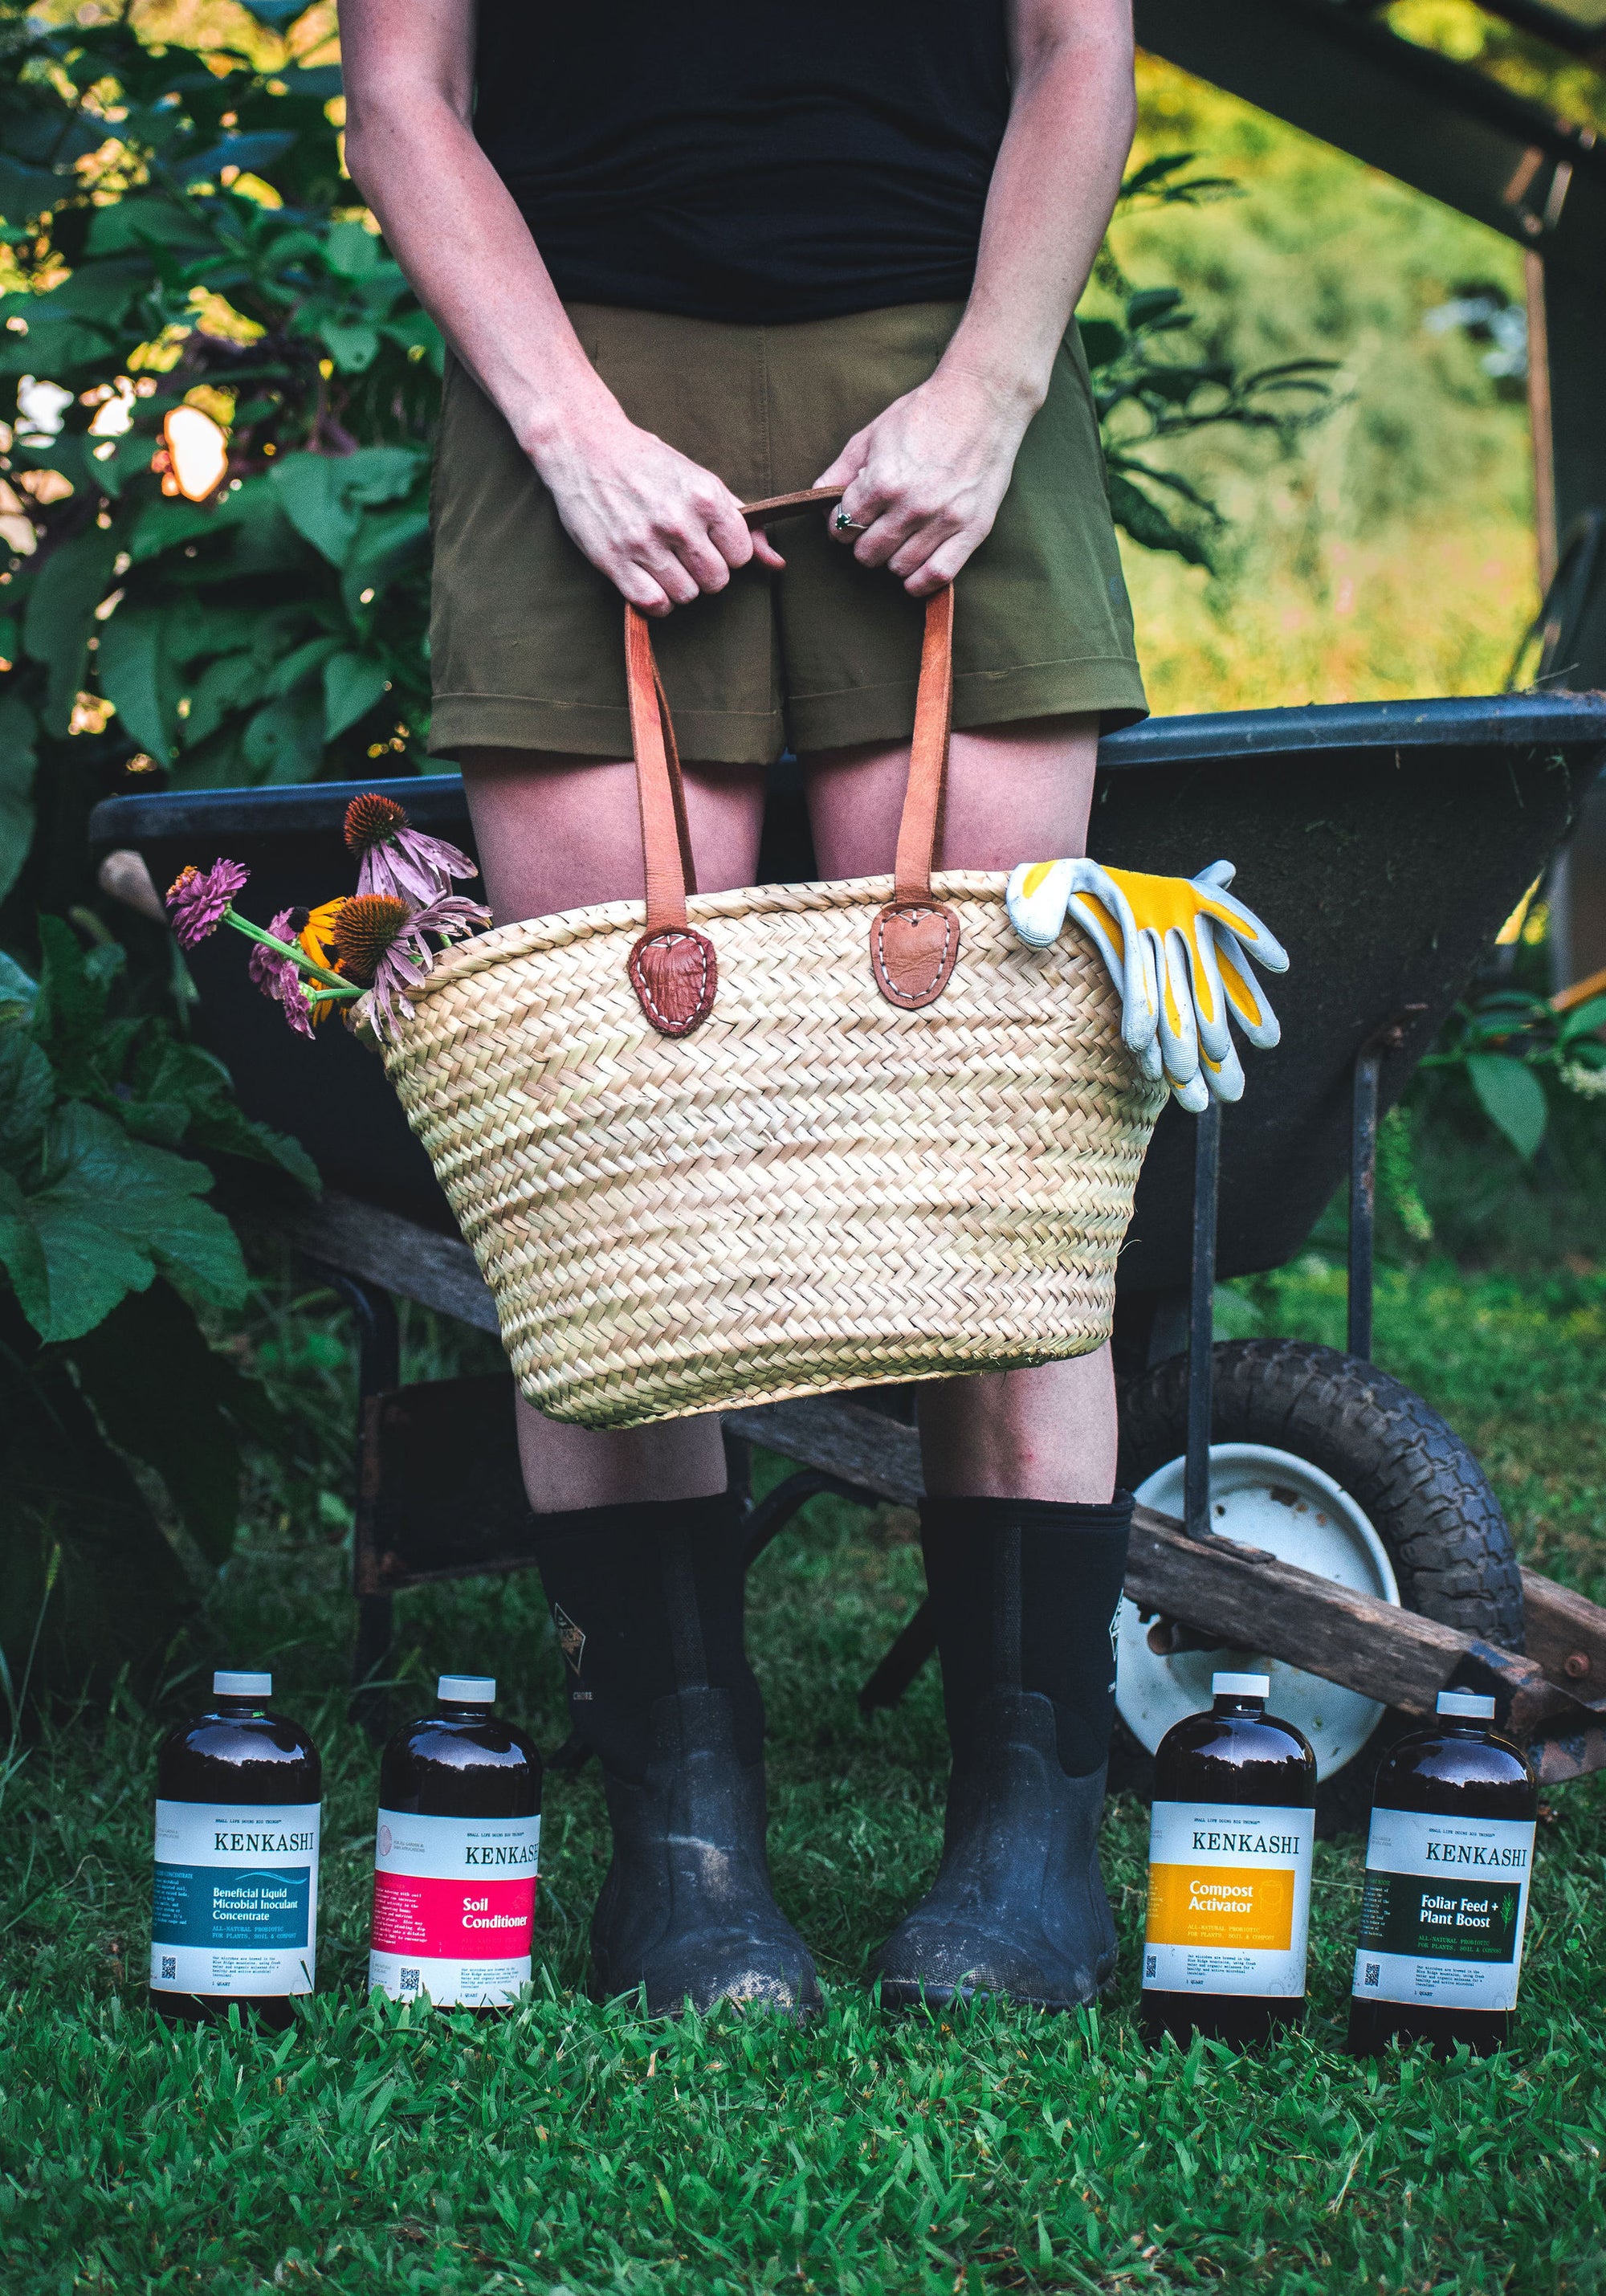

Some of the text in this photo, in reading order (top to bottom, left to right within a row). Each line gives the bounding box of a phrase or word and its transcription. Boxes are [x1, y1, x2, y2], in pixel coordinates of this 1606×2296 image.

[214, 1832, 314, 1852] KENKASHI
[1192, 1833, 1300, 1854] KENKASHI
[465, 1842, 539, 1865] KENKASH
[1426, 1842, 1527, 1866] KENKASHI
[214, 1887, 287, 1900] Beneficial Liquid
[1189, 1880, 1253, 1898] Compost
[213, 1898, 298, 1910] Microbial Inoculant
[463, 1897, 488, 1911] Soil
[1188, 1896, 1253, 1913] Activator
[1421, 1894, 1498, 1913] Foliar Feed +
[213, 1910, 270, 1920] Concentrate
[463, 1915, 528, 1929] Conditioner
[1421, 1910, 1490, 1927] Plant Boost
